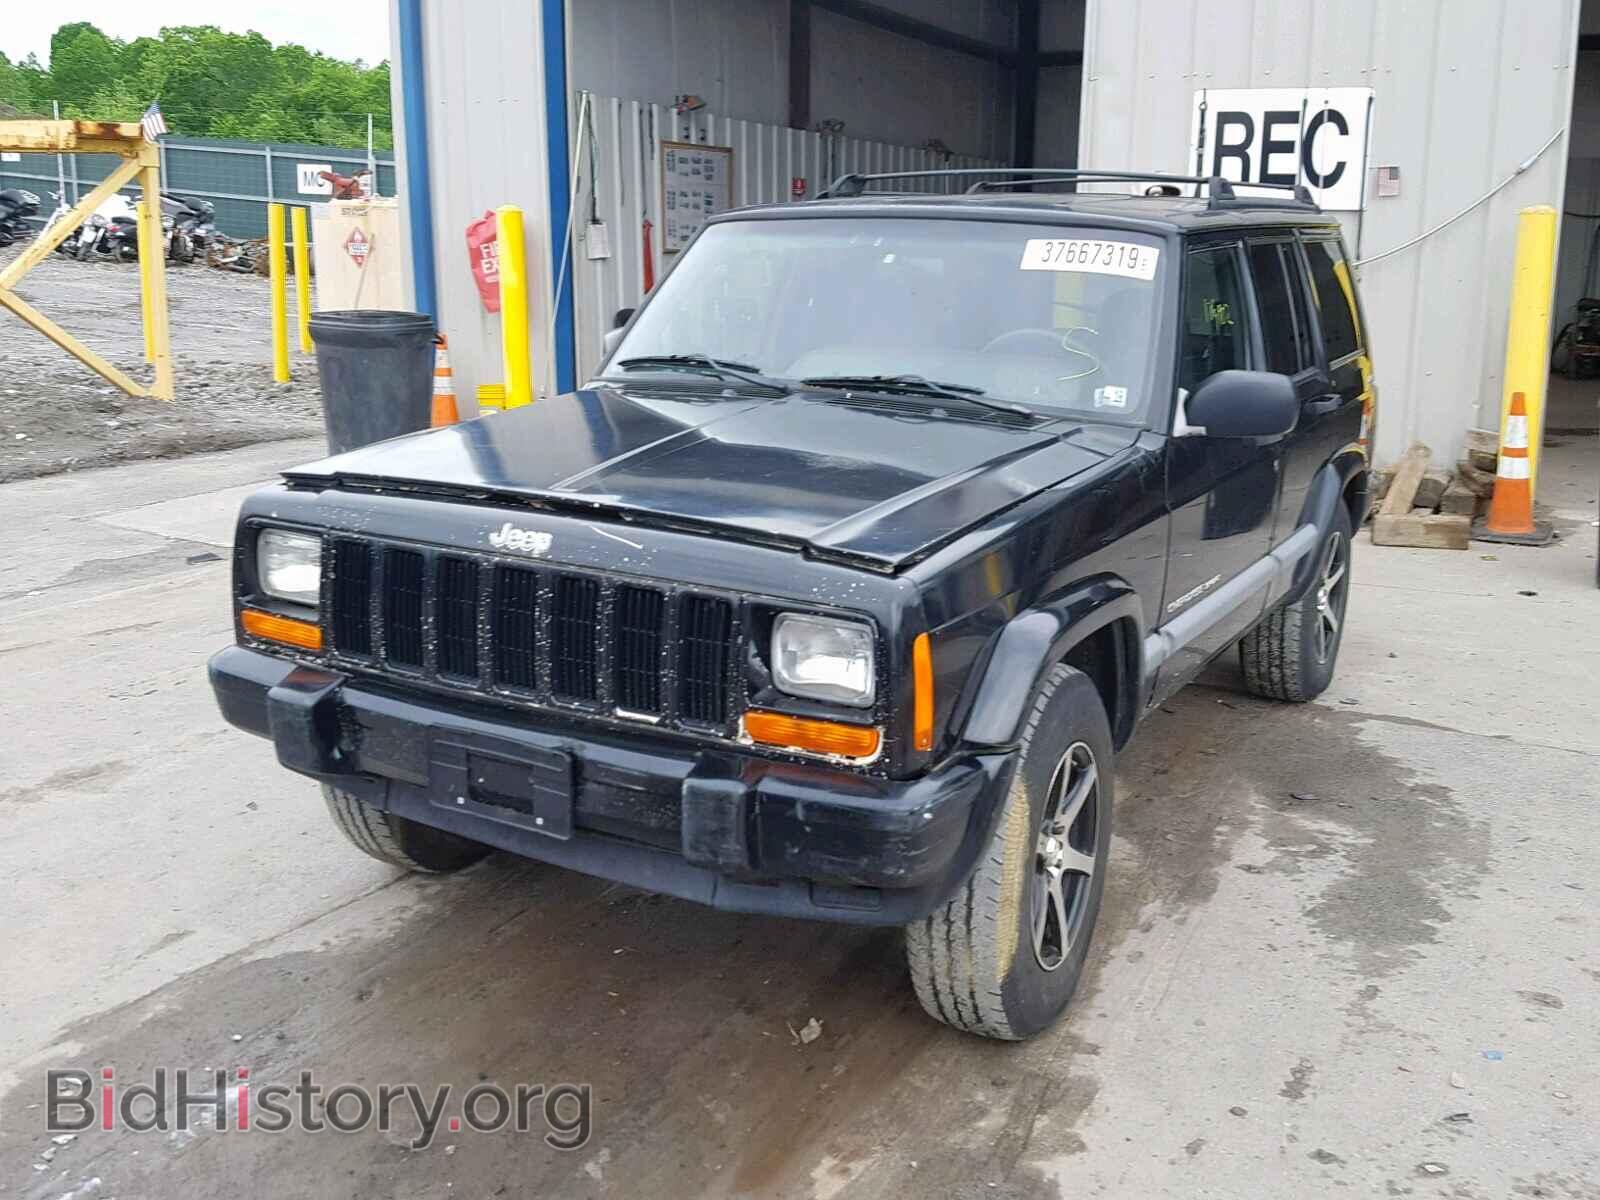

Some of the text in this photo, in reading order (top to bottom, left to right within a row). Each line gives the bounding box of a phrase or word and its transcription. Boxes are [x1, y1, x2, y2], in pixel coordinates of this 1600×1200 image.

[1212, 108, 1349, 189] REC
[1040, 241, 1140, 270] 37667319
[489, 522, 554, 557] Jeep
